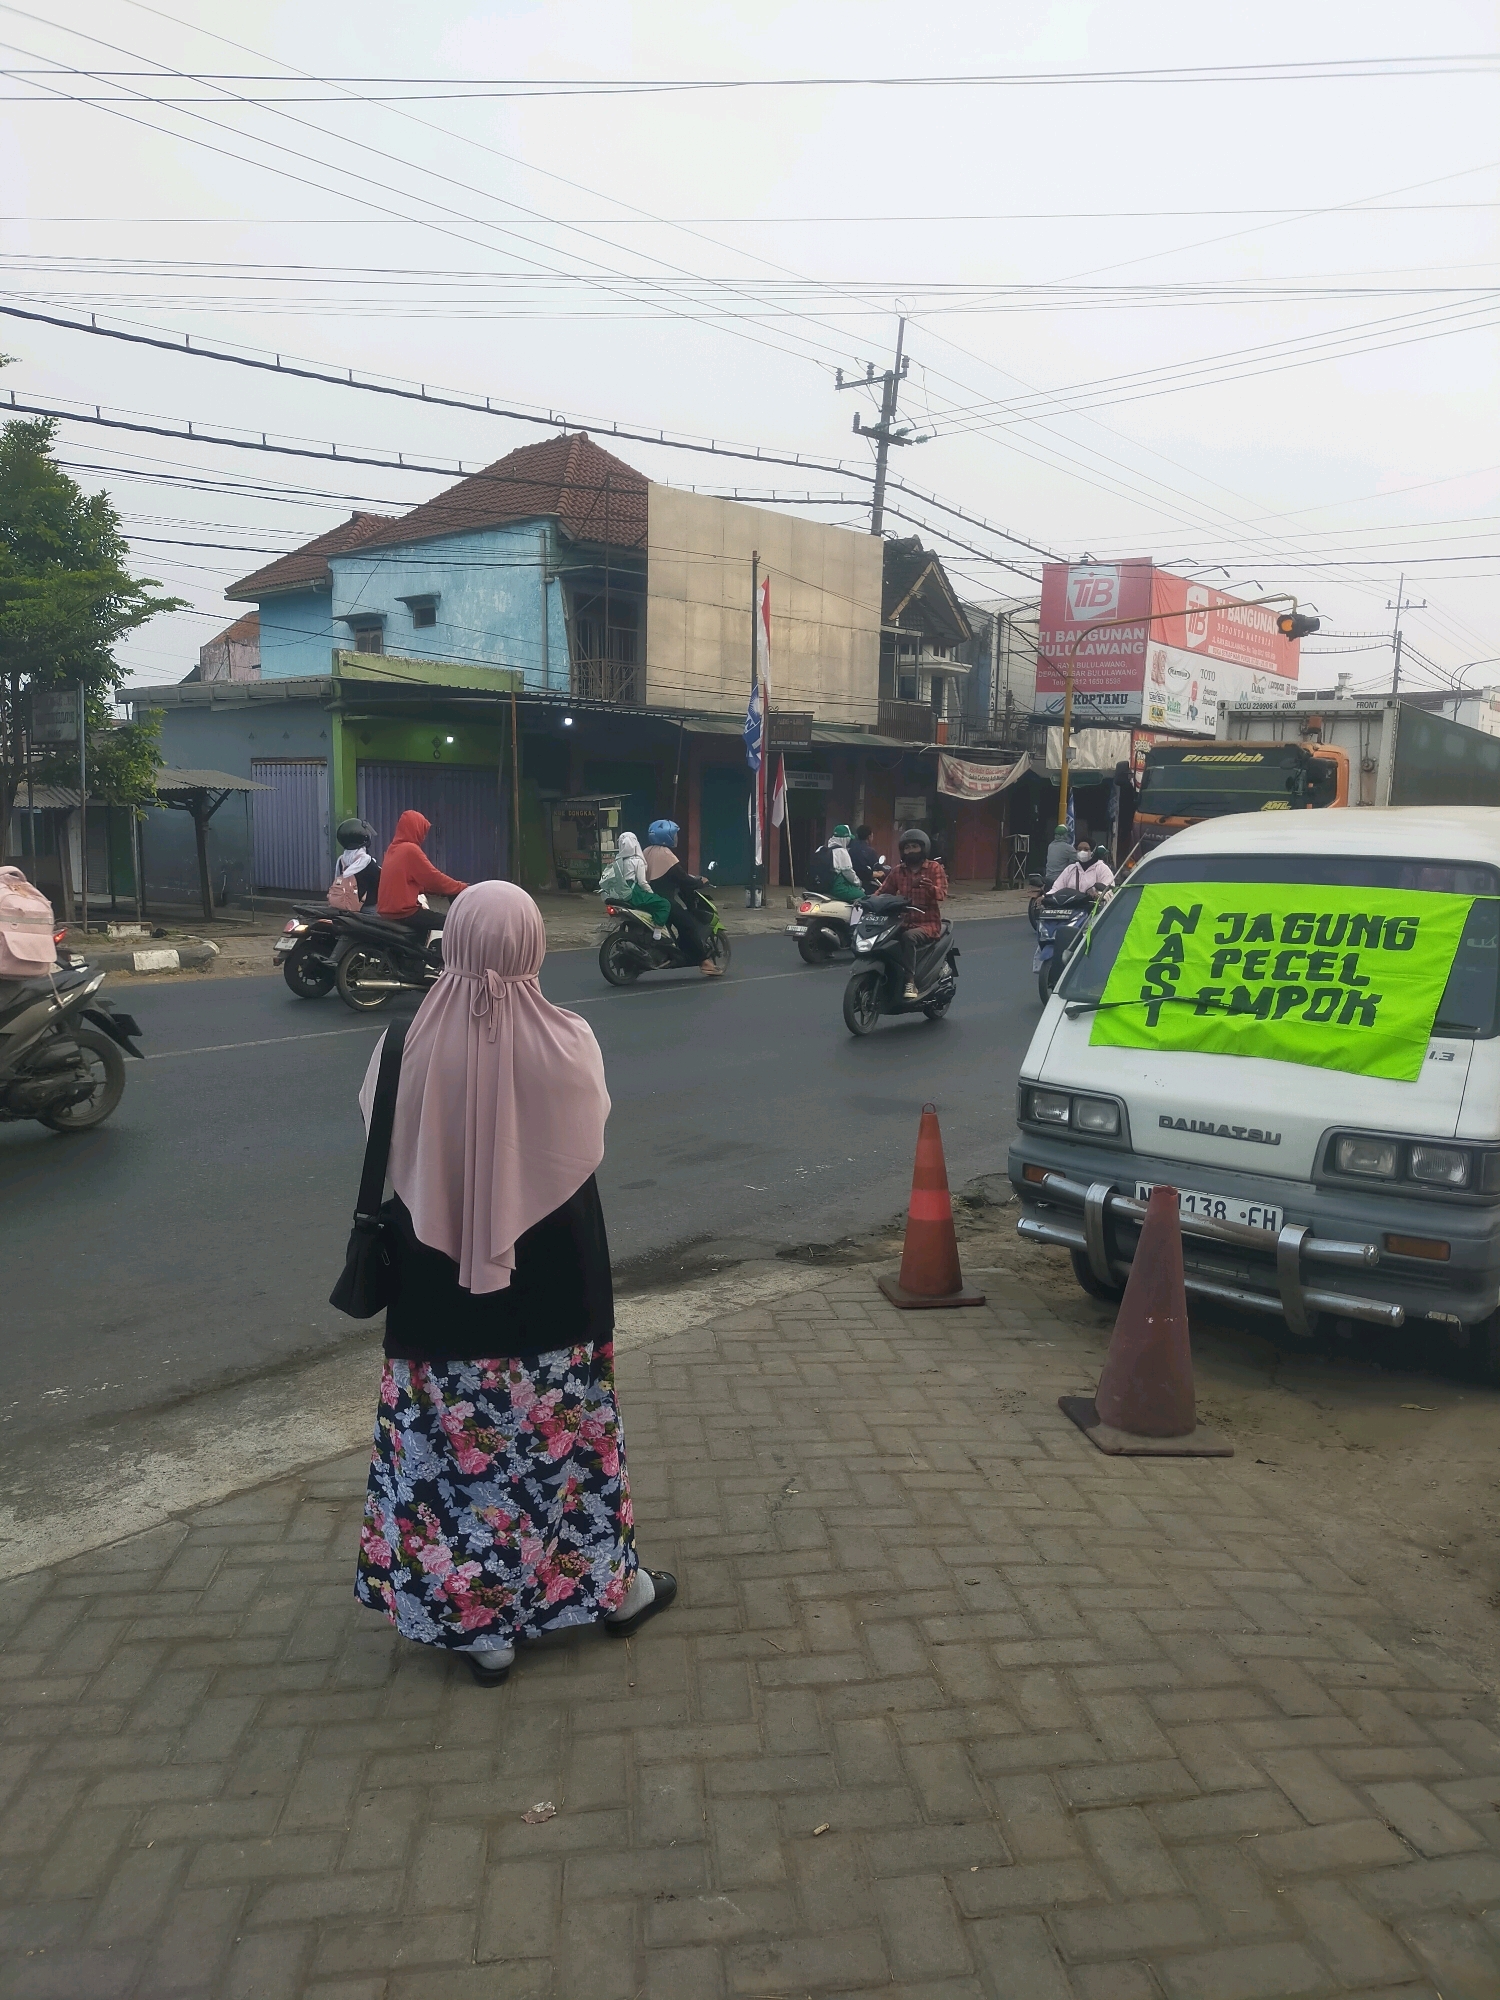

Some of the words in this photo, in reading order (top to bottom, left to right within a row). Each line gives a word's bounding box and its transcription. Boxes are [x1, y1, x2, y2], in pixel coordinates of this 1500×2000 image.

[1227, 601, 1279, 635] BANGUNAN
[1055, 628, 1145, 643] BANGUNAN
[1038, 642, 1144, 657] BULULAWANG
[1073, 694, 1129, 705] KOPTANU
[1181, 752, 1264, 762] Bismillah
[1214, 912, 1420, 950] JAGUNG
[1210, 948, 1371, 986] PECEL
[1194, 985, 1383, 1028] EMPOK
[1428, 1051, 1455, 1062] 1.3
[1158, 1115, 1281, 1146] DAIHATSU
